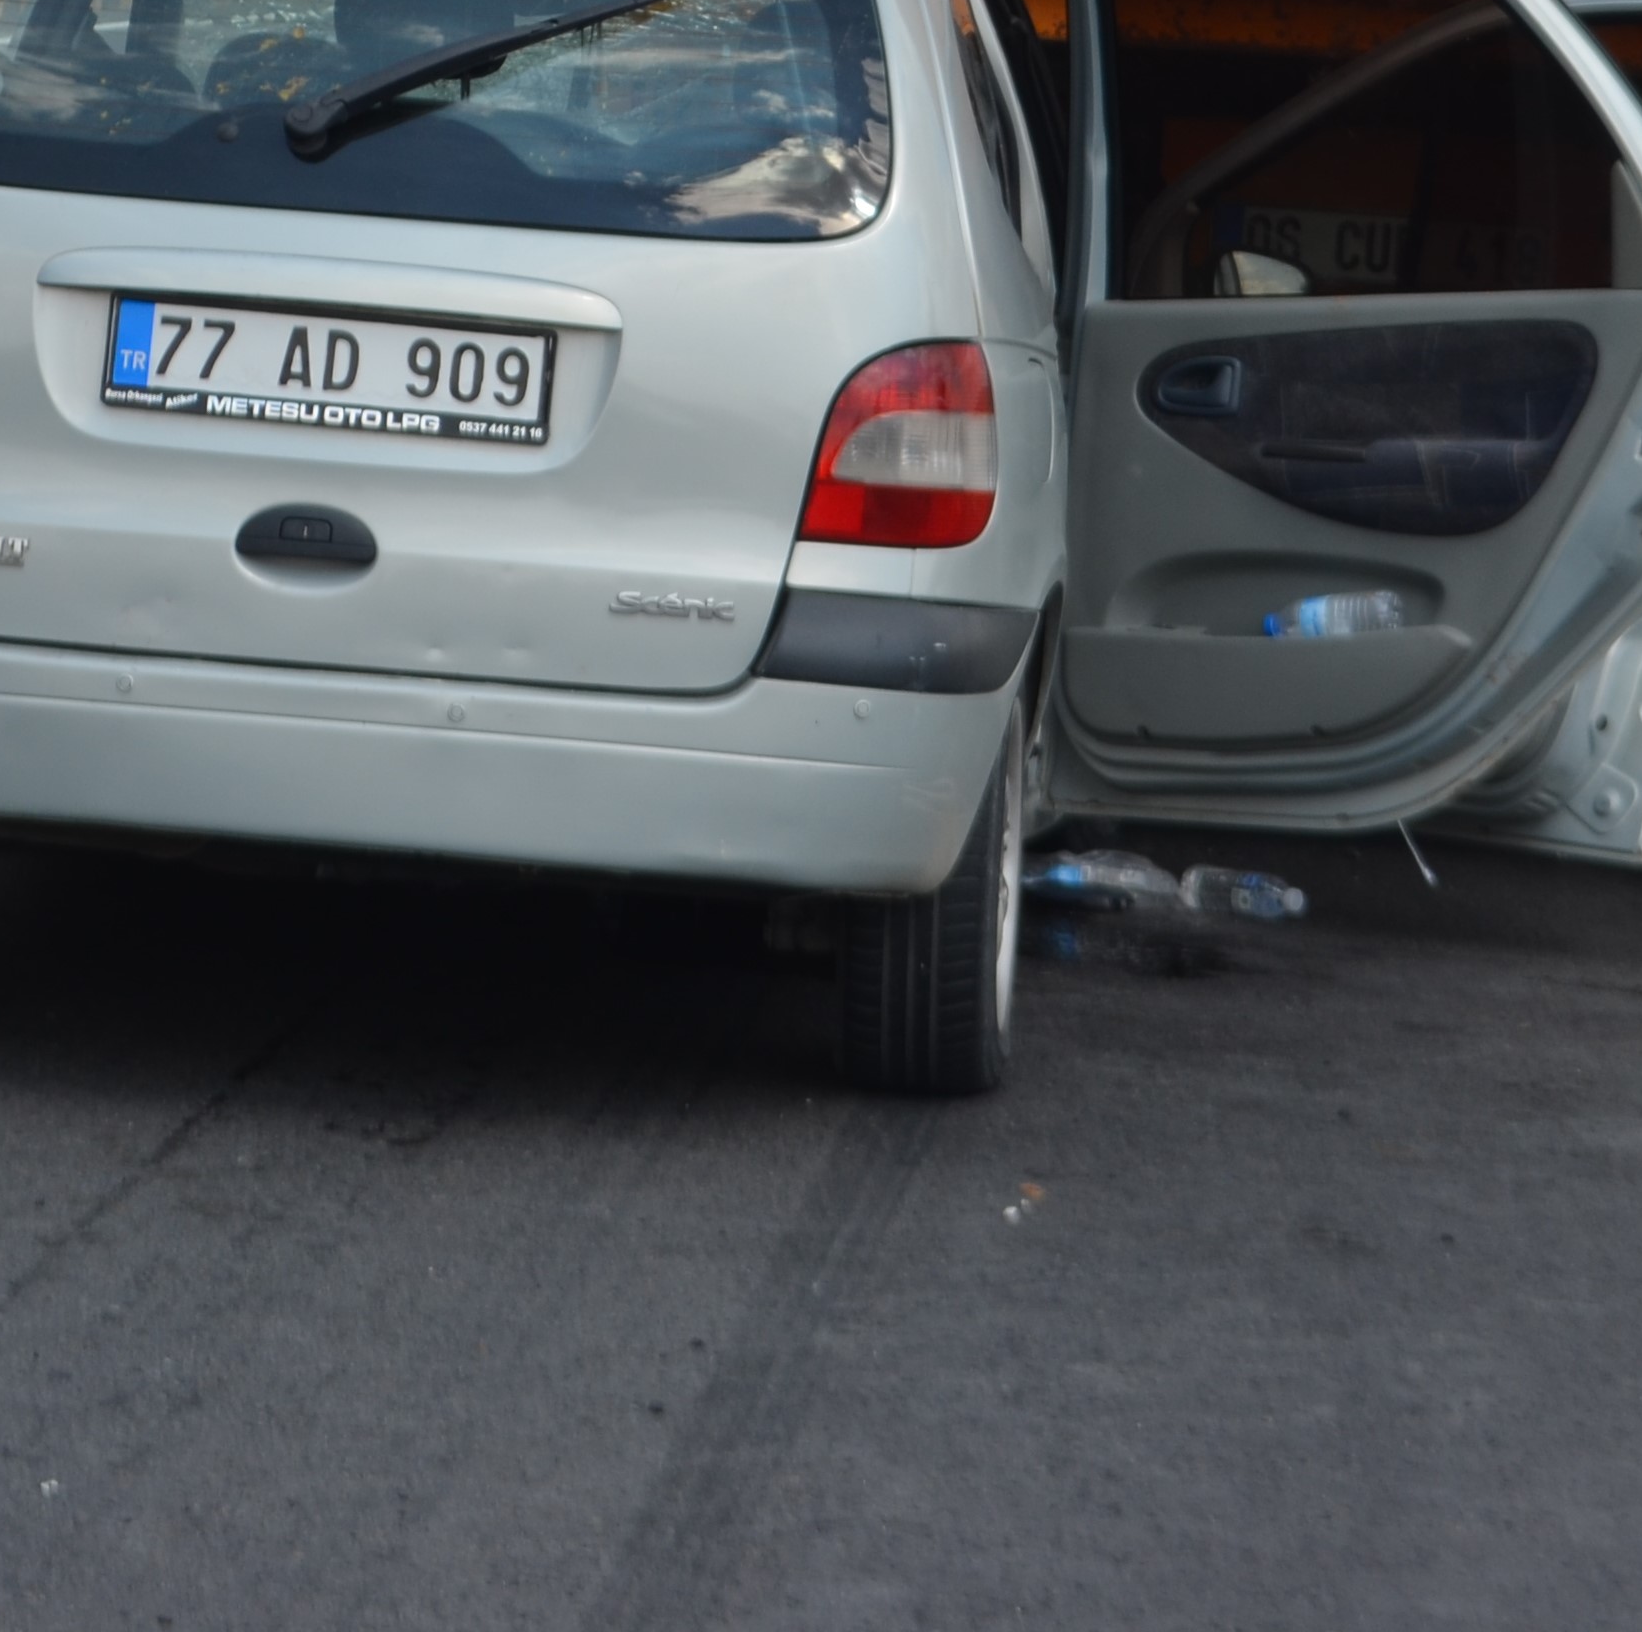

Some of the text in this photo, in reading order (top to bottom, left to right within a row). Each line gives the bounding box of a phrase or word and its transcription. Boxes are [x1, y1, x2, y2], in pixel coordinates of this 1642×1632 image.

[121, 349, 146, 371] TR
[155, 315, 530, 408] 77 AD 909
[206, 394, 441, 434] METESU OTO LPG
[458, 420, 487, 434] 0537
